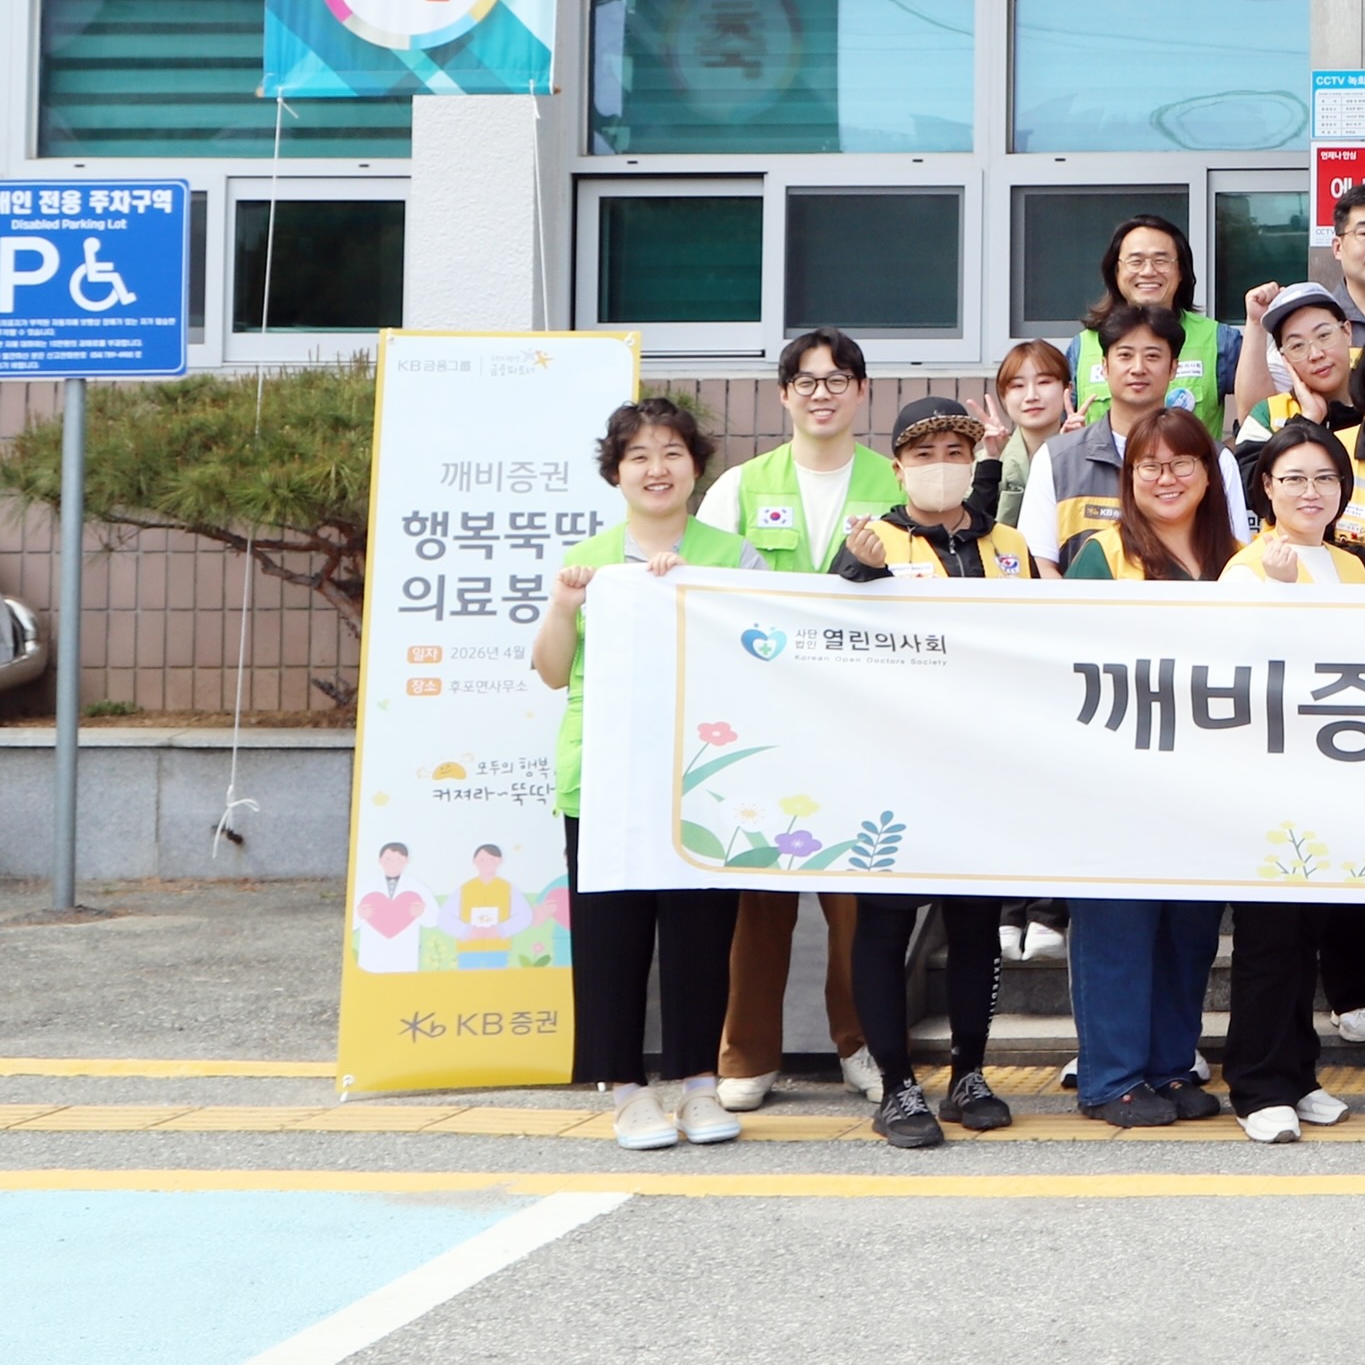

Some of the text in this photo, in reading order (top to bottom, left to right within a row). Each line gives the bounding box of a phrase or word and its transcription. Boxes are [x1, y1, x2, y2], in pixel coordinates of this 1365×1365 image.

[1316, 76, 1345, 85] CCTV
[1343, 151, 1357, 160] 안심
[39, 189, 82, 215] 전용
[89, 189, 173, 214] 주차구역
[11, 218, 128, 231] Disabled Parking Lot
[0, 236, 60, 314] P
[440, 460, 570, 494] 깨비증권
[401, 510, 604, 561] 행복뚝딱
[398, 573, 549, 624] 의료봉
[796, 629, 818, 639] 사단
[823, 628, 948, 655] 열린의사회
[413, 645, 525, 662] 일자 2026년 4월
[794, 654, 948, 667] Korean Open Doctors Society
[412, 679, 528, 694] 장소 후포면사무소
[476, 760, 514, 776] 모두의
[456, 1010, 558, 1036] KB증권
